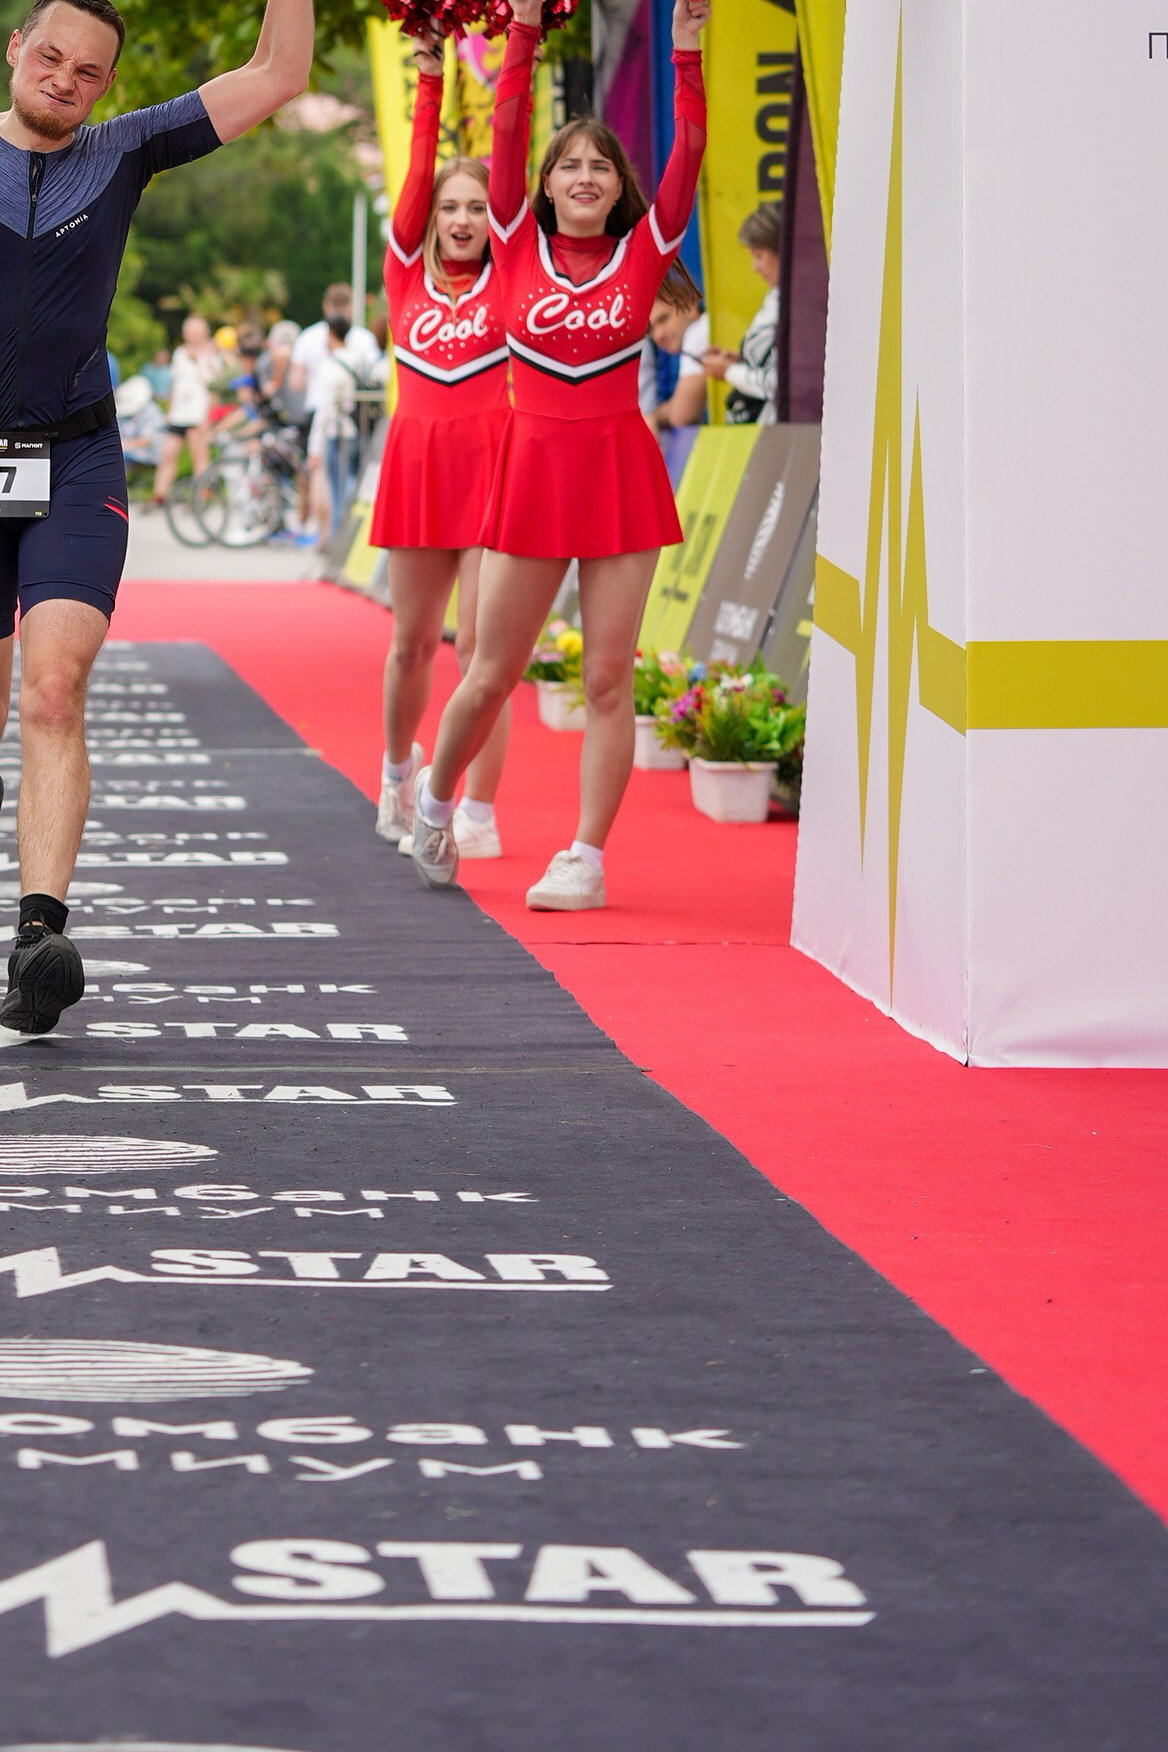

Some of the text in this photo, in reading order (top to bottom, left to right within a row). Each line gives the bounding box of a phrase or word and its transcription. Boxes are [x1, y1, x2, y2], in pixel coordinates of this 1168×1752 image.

[54, 213, 89, 238] APTONIA
[409, 305, 488, 351] Cool
[525, 293, 626, 335] Cool
[85, 1021, 409, 1041] STAR
[97, 1084, 455, 1100] STAR
[150, 1248, 610, 1282] STAR
[229, 1538, 868, 1607] STAR
